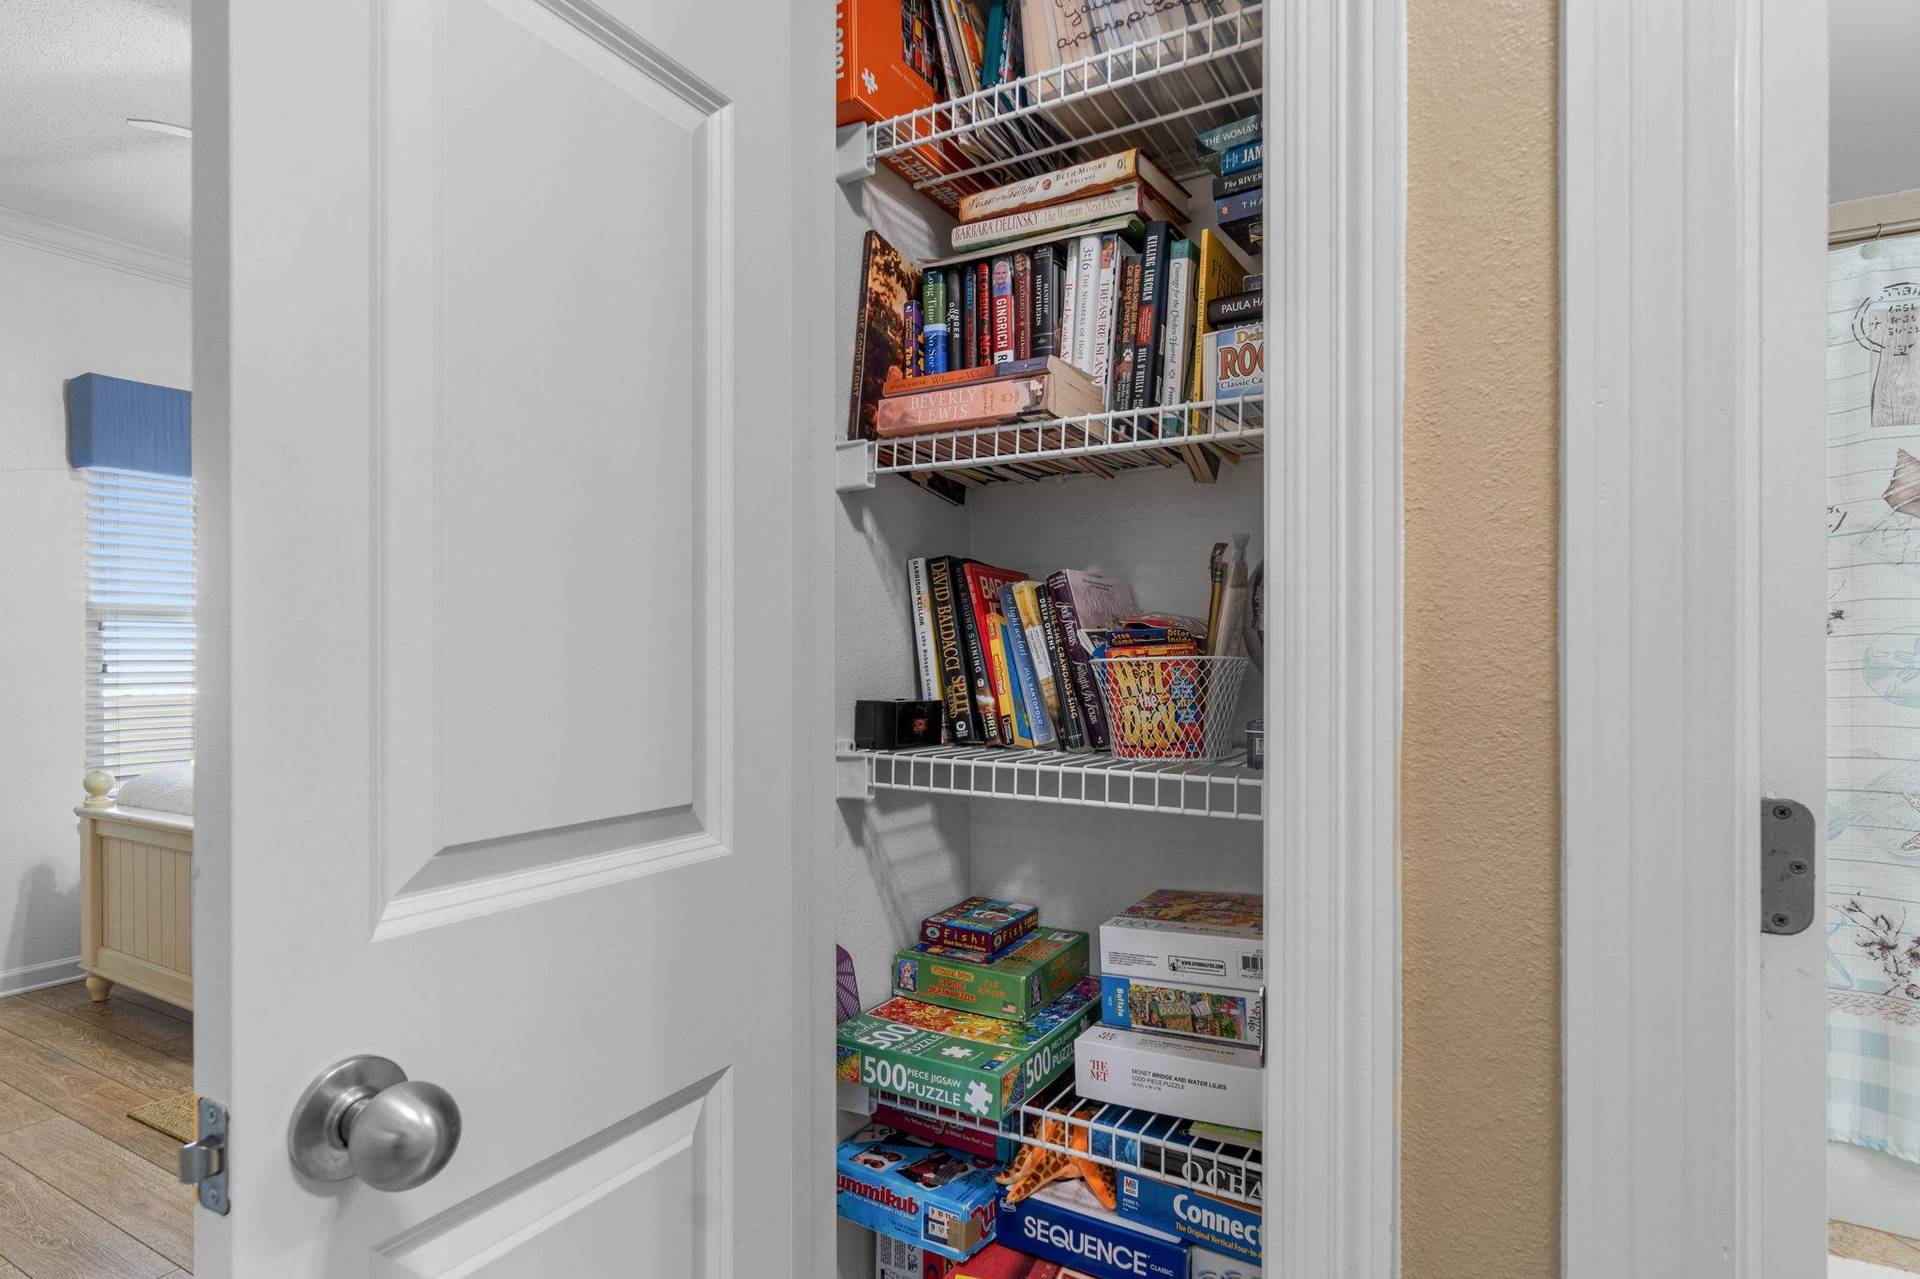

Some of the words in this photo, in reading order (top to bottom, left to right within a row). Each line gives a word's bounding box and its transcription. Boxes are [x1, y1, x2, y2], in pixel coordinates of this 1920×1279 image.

[1205, 134, 1221, 148] THE
[1222, 122, 1259, 140] WOMAN
[1055, 170, 1076, 181] BETH
[1076, 162, 1107, 177] MOORE
[1224, 180, 1237, 190] The
[954, 224, 994, 241] BARBARA
[994, 211, 1041, 234] DELINSKY
[1081, 247, 1094, 271] 3:16
[1146, 235, 1158, 266] KILLING
[926, 270, 937, 297] Long
[1082, 274, 1090, 289] THE
[1142, 268, 1155, 301] LINCOLN
[1170, 262, 1184, 289] Courage
[927, 297, 937, 324] Time
[1079, 291, 1089, 326] NUMBERS
[1097, 280, 1110, 339] TREASURE
[1221, 299, 1251, 314] PAULA
[996, 297, 1008, 348] GINGRICH
[1169, 310, 1180, 335] Chicken
[855, 332, 863, 362] GOOD
[928, 332, 937, 347] No
[1093, 342, 1105, 385] ISLAND
[1138, 348, 1147, 362] BILL
[853, 365, 861, 397] FIGHT
[1135, 364, 1146, 394] O'REILLY
[1220, 378, 1250, 390] Classic
[911, 387, 976, 410] BEVERLY
[917, 405, 968, 424] LEWIS
[912, 560, 922, 595] GARRISON
[931, 561, 950, 601] DAVID
[916, 596, 925, 626] KEILLOR
[1039, 597, 1048, 621] DELIA
[1045, 623, 1056, 652] OWENS
[937, 604, 960, 672] BALDACCI
[960, 592, 974, 632] AROUND
[969, 633, 982, 673] SHINING
[1053, 627, 1061, 644] THE
[1167, 629, 1190, 637] Offer
[1008, 606, 1018, 626] light
[1017, 641, 1027, 657] lost
[1028, 682, 1043, 726] SANTOPOLO
[1056, 646, 1074, 698] CRAWDADS
[1060, 617, 1078, 646] Thomas
[1072, 661, 1090, 693] Twilight
[1085, 702, 1098, 725] Texas
[946, 685, 957, 719] SECOND
[952, 674, 970, 715] SPLIT
[1067, 698, 1078, 720] SING
[1111, 917, 1164, 929] 1000
[858, 1023, 918, 1050] 500
[902, 1034, 943, 1053] PUZZLE
[863, 1055, 907, 1092] 500
[906, 1068, 929, 1081] PIECE
[931, 1074, 961, 1088] JIGSAW
[1026, 1046, 1051, 1089] 500
[1090, 1059, 1108, 1072] THE
[1090, 1070, 1109, 1082] MET
[1131, 1068, 1151, 1077] MONET
[1152, 1072, 1173, 1081] BRIDGE
[1187, 1078, 1208, 1087] WATER
[1208, 1082, 1227, 1090] LILIES
[907, 1081, 961, 1107] PUZZLE
[1163, 1081, 1185, 1090] PUZZLE
[837, 1174, 920, 1215] ummikub
[1125, 1178, 1137, 1190] MB
[1023, 1216, 1148, 1277] SEQUENCE
[1150, 1264, 1174, 1277] CLASSIC
[1176, 1222, 1186, 1233] The
[1187, 1228, 1210, 1241] Original
[1211, 1231, 1234, 1249] Vertical
